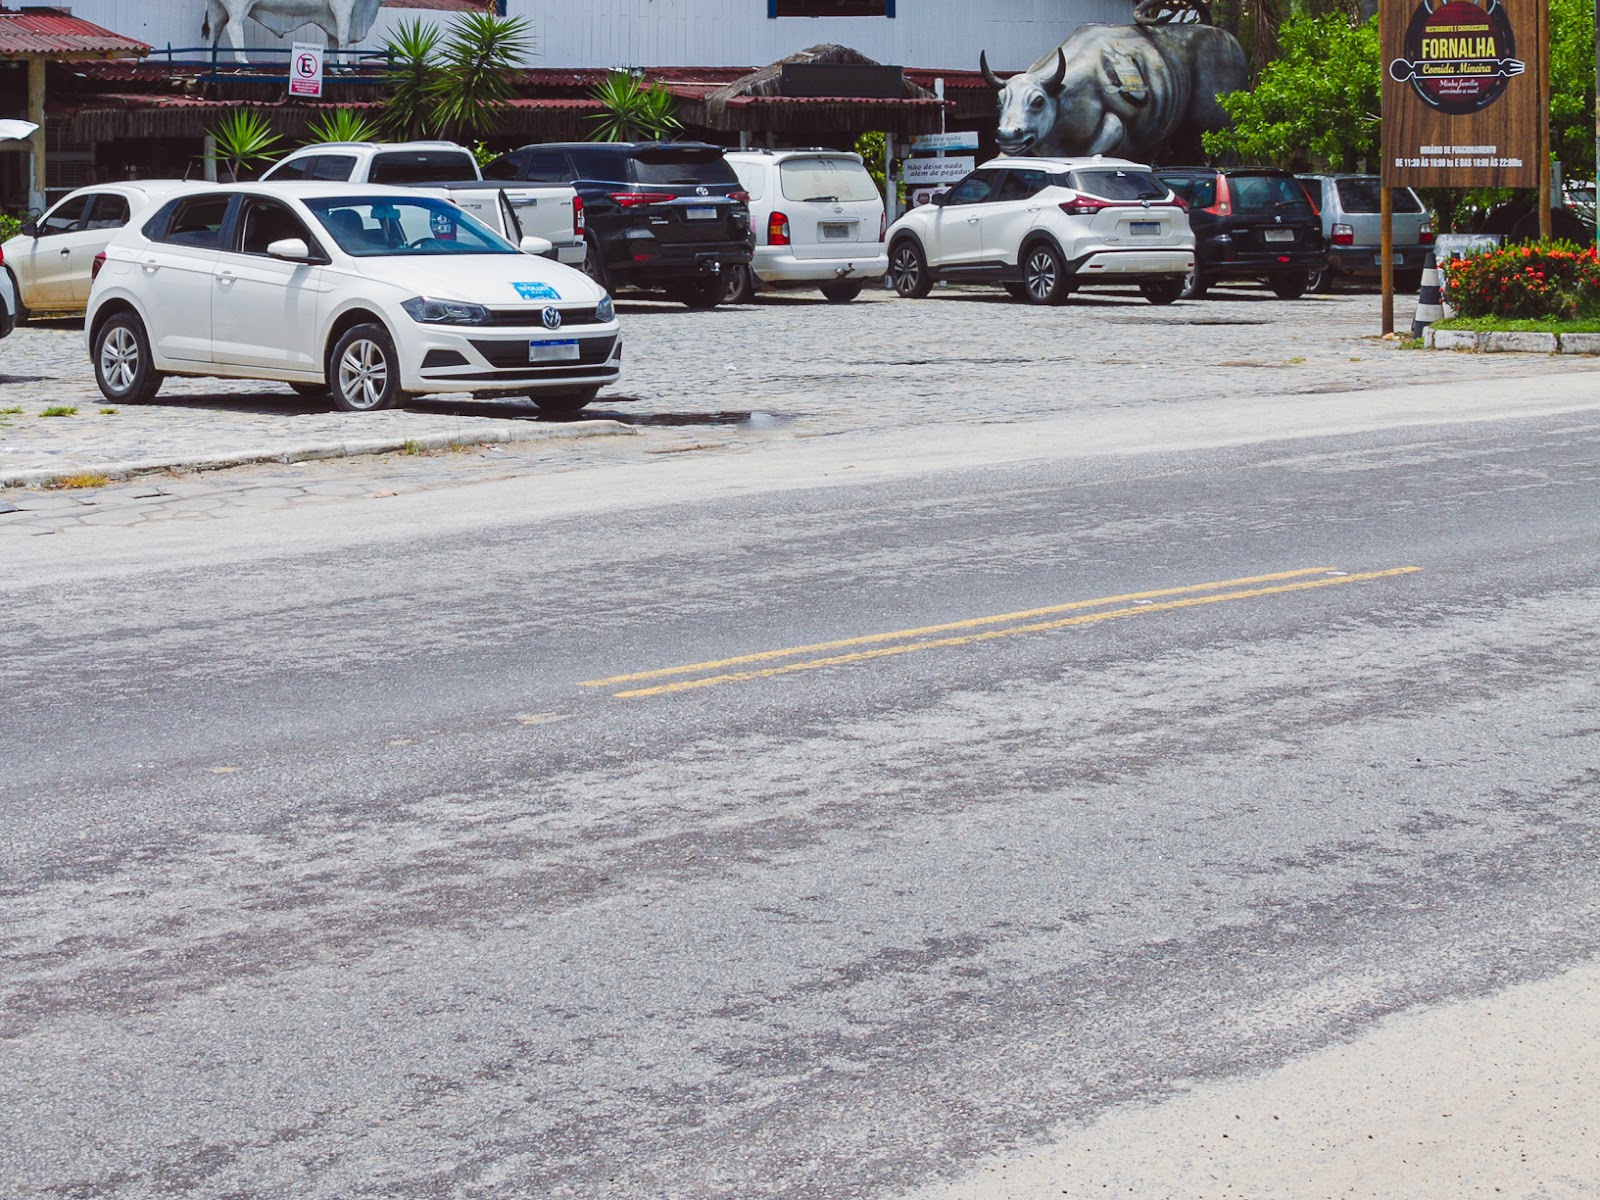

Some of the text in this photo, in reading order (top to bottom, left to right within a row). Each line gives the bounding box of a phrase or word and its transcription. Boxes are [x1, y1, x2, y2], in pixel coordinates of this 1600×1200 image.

[1422, 37, 1496, 59] FORNALHA
[1422, 62, 1492, 74] Comida Mineira
[1444, 146, 1451, 154] DE
[1395, 158, 1403, 167] DE
[1460, 158, 1472, 167] DAS
[910, 169, 928, 177] além
